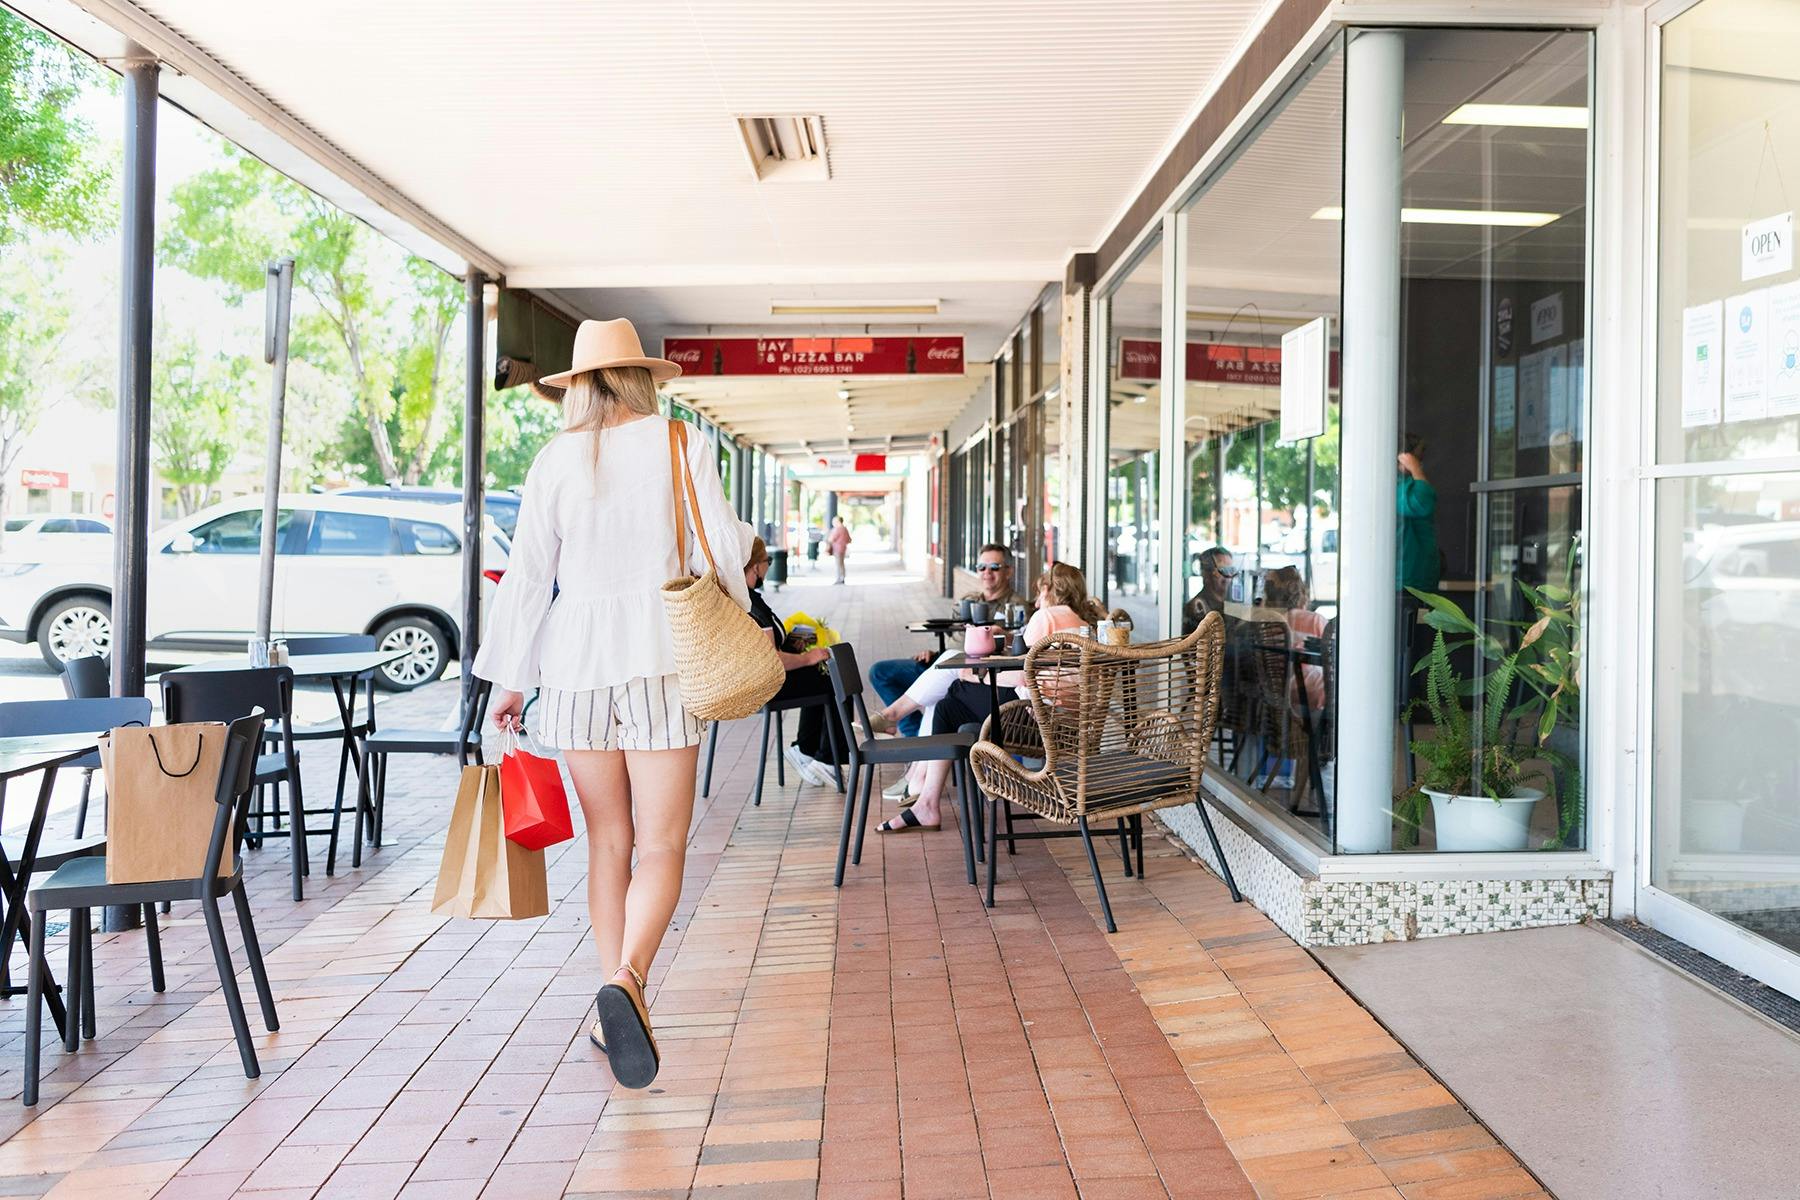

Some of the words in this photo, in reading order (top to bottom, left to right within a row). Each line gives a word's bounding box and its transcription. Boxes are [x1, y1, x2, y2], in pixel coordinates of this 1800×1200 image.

[1752, 231, 1780, 256] OPEN
[766, 353, 775, 363] &
[782, 352, 827, 363] PIZZA
[834, 352, 864, 363] BAR
[793, 366, 812, 374] (02)
[813, 365, 834, 374] 6993
